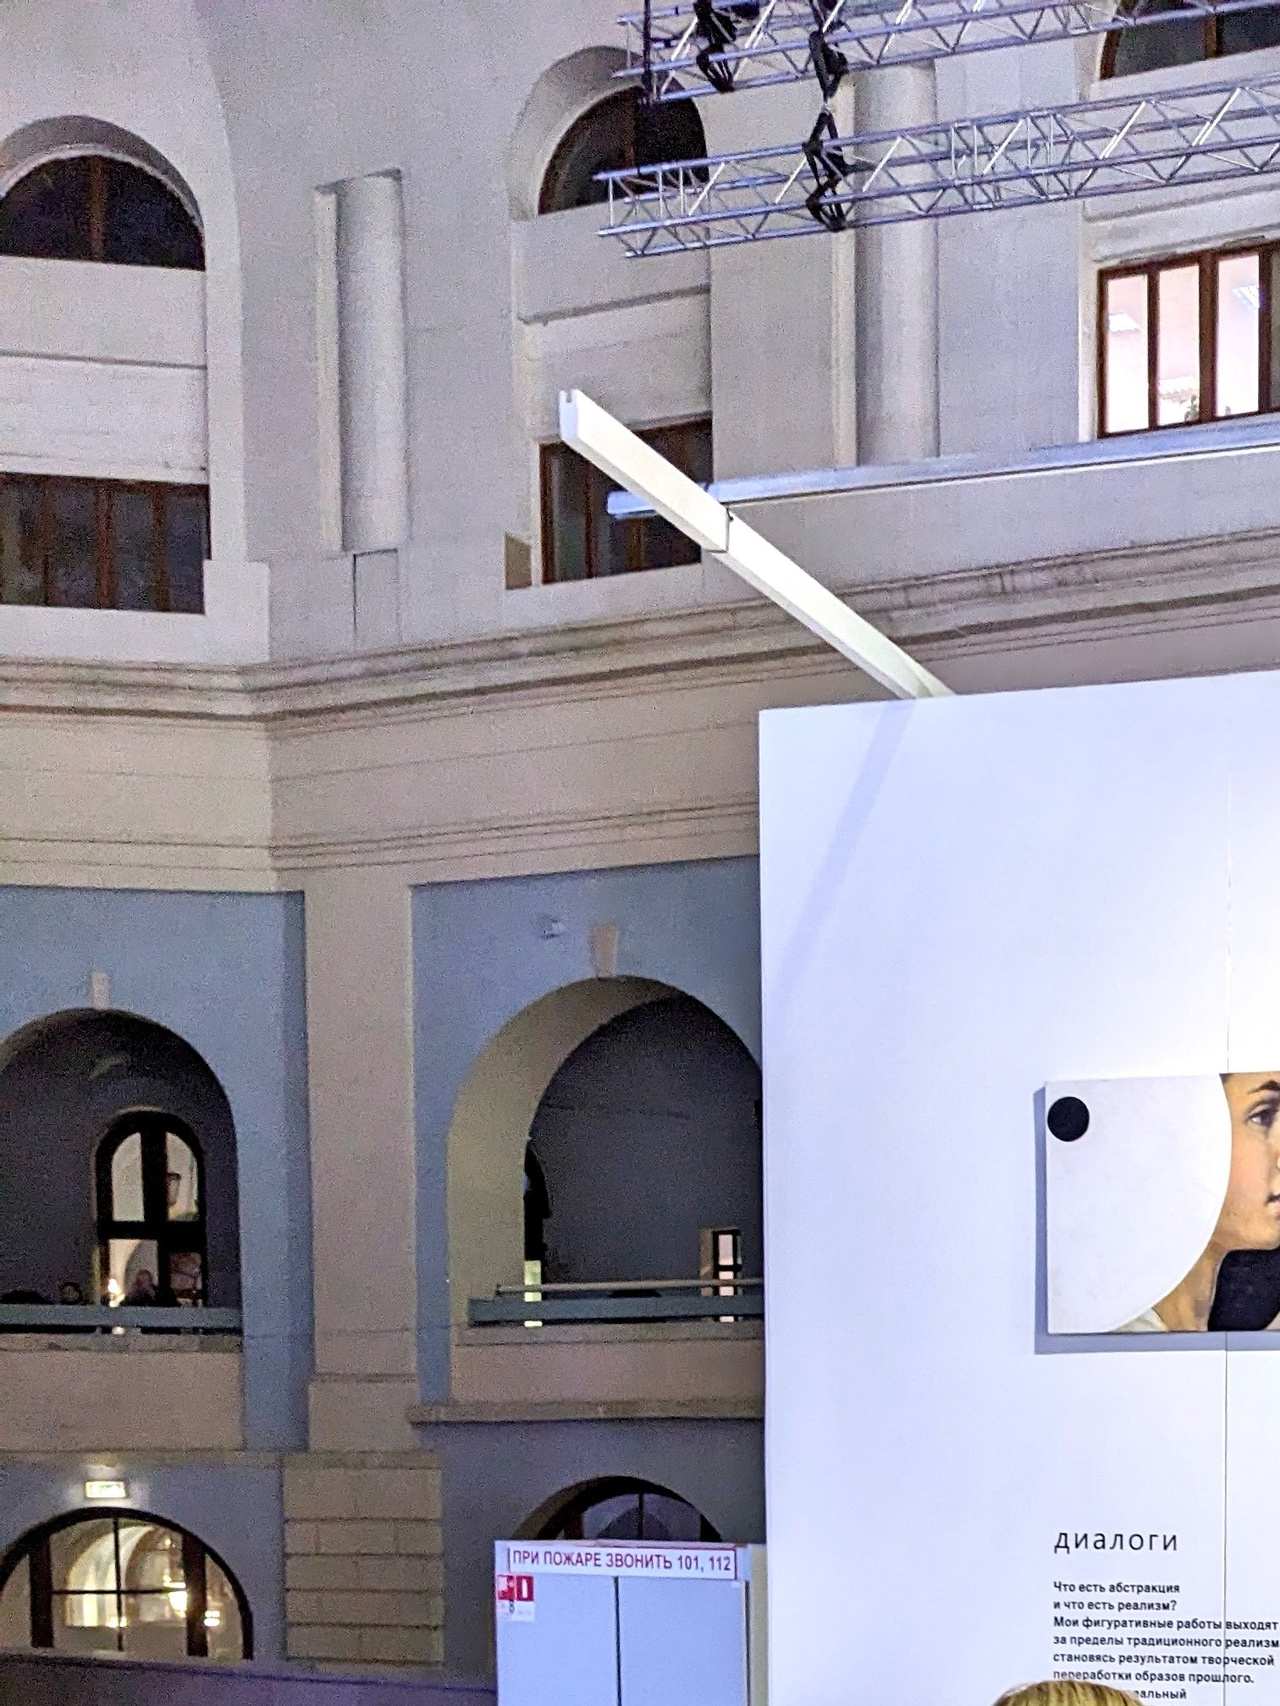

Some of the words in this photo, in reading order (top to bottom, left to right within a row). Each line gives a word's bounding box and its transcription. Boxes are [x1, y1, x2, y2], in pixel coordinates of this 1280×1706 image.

[1053, 1532, 1178, 1554] диалоги
[513, 1550, 539, 1565] ПРИ
[544, 1551, 602, 1567] ПОЖАРЕ
[605, 1553, 673, 1569] ЗВОНИТЬ
[677, 1556, 705, 1572] 101,
[709, 1556, 732, 1571] 112
[1053, 1581, 1076, 1592] Что
[1078, 1583, 1106, 1593] есть
[1108, 1582, 1180, 1595] абстракция
[1053, 1601, 1060, 1610] и
[1064, 1601, 1085, 1610] что
[1087, 1601, 1115, 1611] есть
[1117, 1600, 1177, 1612] реализм?
[1053, 1616, 1079, 1627] Мои
[1082, 1616, 1174, 1630] фигуративные
[1176, 1617, 1222, 1631] работы
[1224, 1620, 1279, 1631] выходят
[1053, 1636, 1067, 1645] за
[1069, 1636, 1124, 1647] пределы
[1126, 1636, 1223, 1648] традиционного
[1053, 1653, 1116, 1662] становясь
[1118, 1655, 1198, 1665] результатом
[1201, 1654, 1275, 1667] творческой
[1135, 1670, 1185, 1683] образов
[1188, 1672, 1255, 1684] прошлого.
